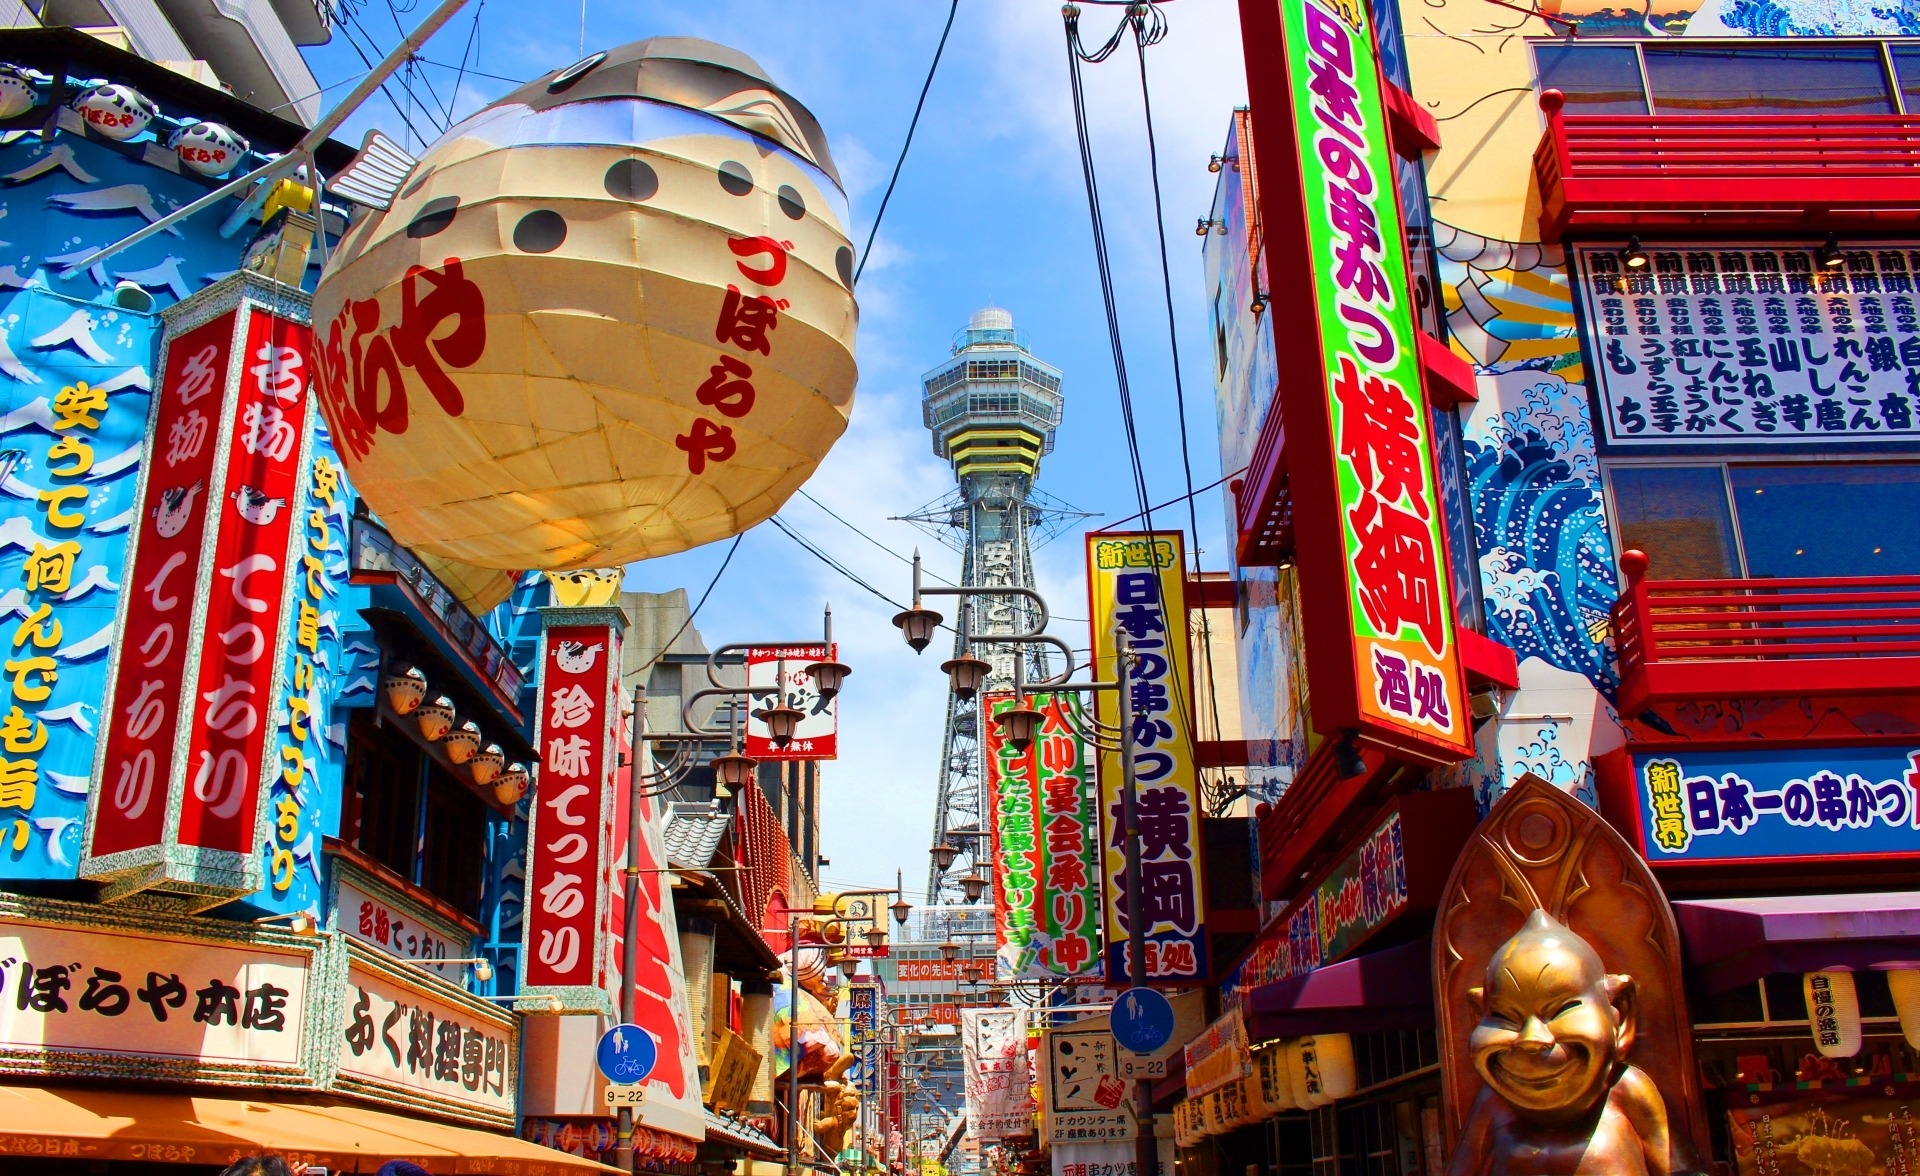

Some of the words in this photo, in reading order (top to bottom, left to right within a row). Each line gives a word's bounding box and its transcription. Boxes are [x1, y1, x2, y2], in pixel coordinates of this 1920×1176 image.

[1305, 1, 1396, 366] 日本一の串かつ
[1622, 252, 1657, 295] 頭
[1814, 252, 1850, 295] 頭
[1600, 298, 1629, 335] 変わり種
[1633, 298, 1661, 335] 変わり種
[1665, 298, 1694, 335] 変わり種
[1698, 298, 1727, 335] 大地の幸
[1731, 297, 1760, 335] 大地の幸
[1763, 297, 1792, 335] 大地の幸
[1795, 297, 1824, 335] 大地の幸
[1826, 297, 1856, 335] 大地の幸
[1858, 296, 1888, 334] 大地の幸
[1891, 296, 1919, 334] 大地の幸
[675, 235, 794, 476] づぼらや
[1606, 338, 1647, 434] もち
[1640, 338, 1683, 433] うずら玉子
[1670, 337, 1717, 433] 紅しょうが
[1703, 338, 1745, 433] にんにく
[1735, 337, 1779, 432] 玉ねぎ
[1769, 337, 1812, 432] 山芋
[1801, 337, 1847, 431] しし唐
[1833, 336, 1881, 431] れんこん
[1865, 336, 1912, 430] 銀杏
[1335, 355, 1443, 656] 横綱
[1098, 542, 1175, 569] 新世界
[0, 381, 108, 852] 安うて何んでも旨い
[114, 550, 188, 820] てっちり
[194, 552, 277, 820] てっちり
[271, 456, 339, 892] 安うて旨いてっちり
[1373, 648, 1453, 735] 酒処
[767, 740, 815, 752] 年無休
[538, 683, 595, 974] 珍味てっちり
[1038, 694, 1090, 973] 大小宴会承り中
[1648, 763, 1688, 849] 新世界
[1686, 774, 1906, 830] 日本一の串かつ
[1108, 786, 1196, 937] 横綱
[358, 900, 446, 972] 名物てっちり
[345, 986, 505, 1099] ふぐ料理専門
[1810, 976, 1841, 1047] 自慢の逸品
[606, 1090, 644, 1104] 9-22
[1125, 1061, 1164, 1075] 9-22
[130, 1144, 196, 1162] づぼらや
[1054, 1129, 1065, 1138] 2F
[1067, 1127, 1127, 1138] 座敷あります
[1055, 1117, 1064, 1126] 1F
[1067, 1115, 1126, 1126] カウンター席
